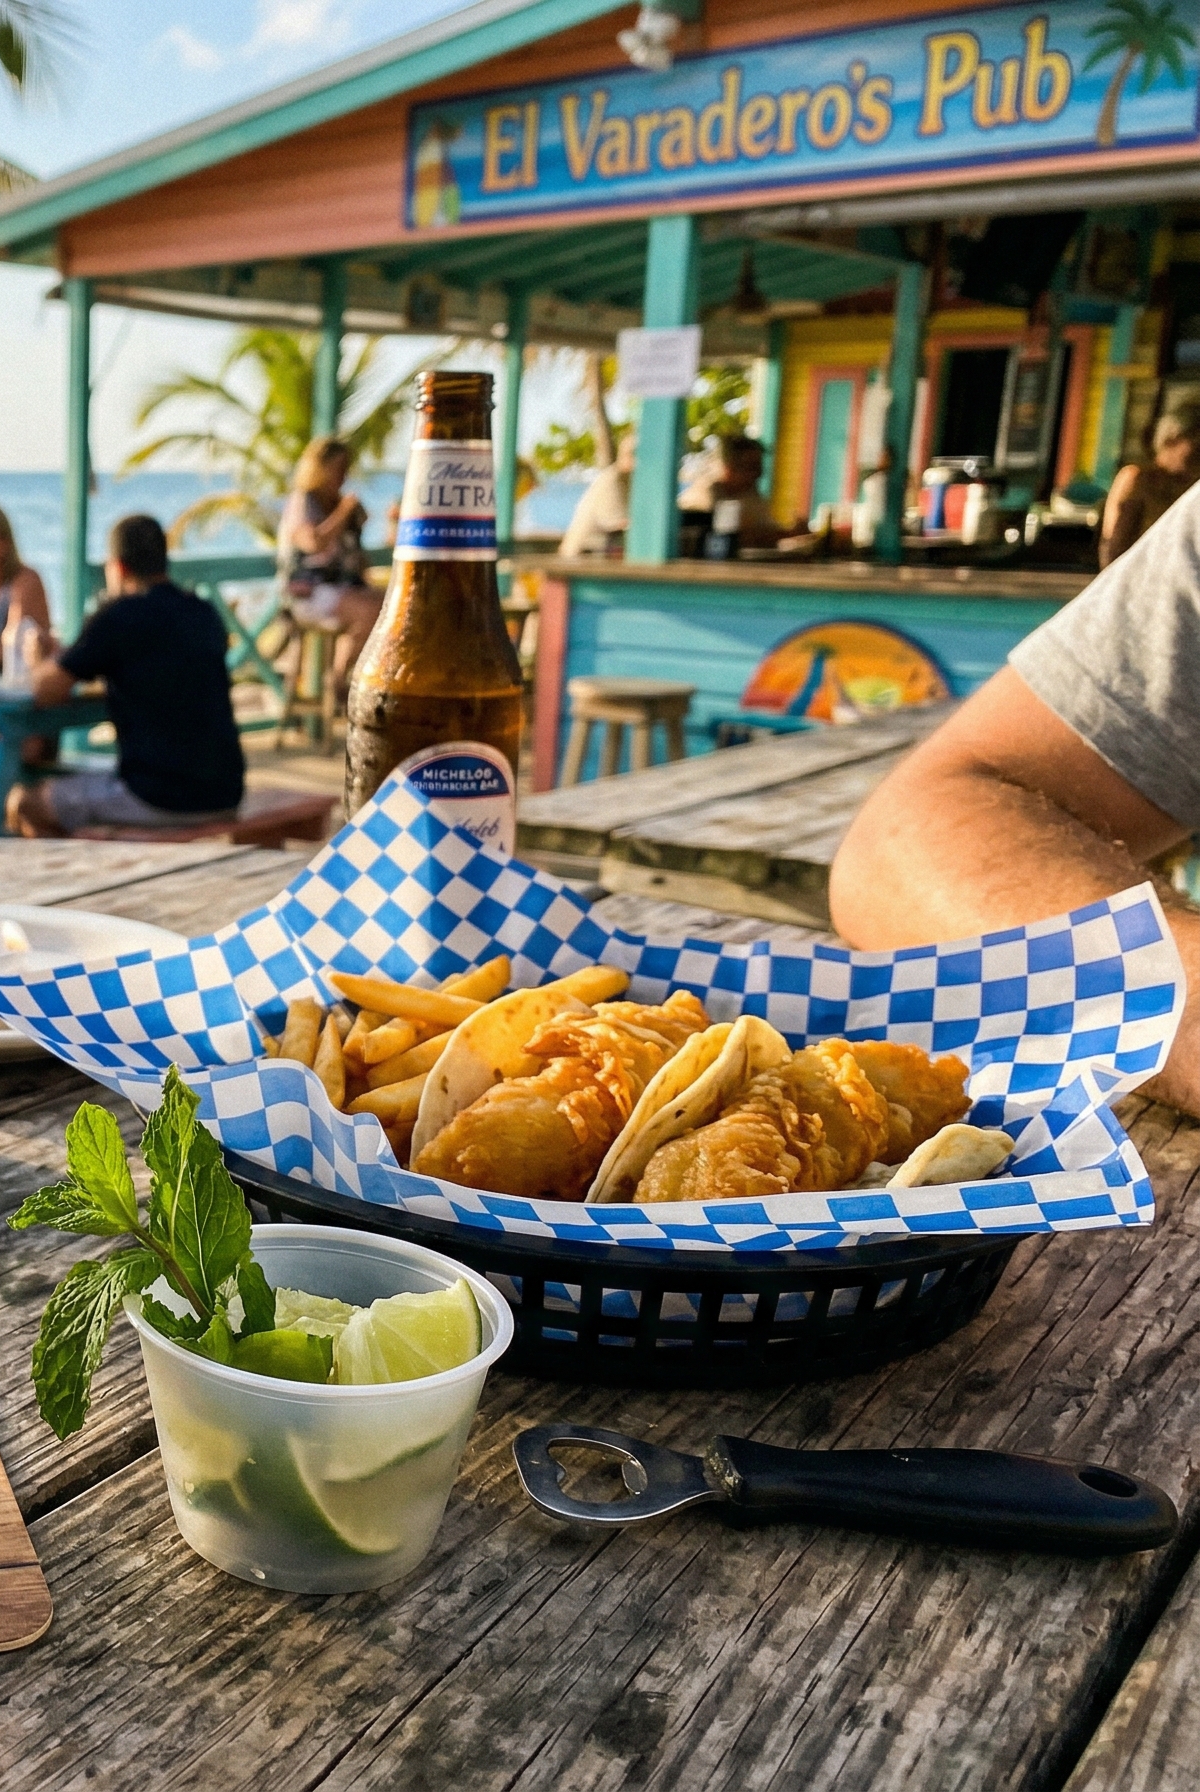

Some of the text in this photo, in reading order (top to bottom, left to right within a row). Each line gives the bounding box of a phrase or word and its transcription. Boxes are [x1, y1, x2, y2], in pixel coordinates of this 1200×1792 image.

[482, 17, 1072, 194] El Varadero's Pub
